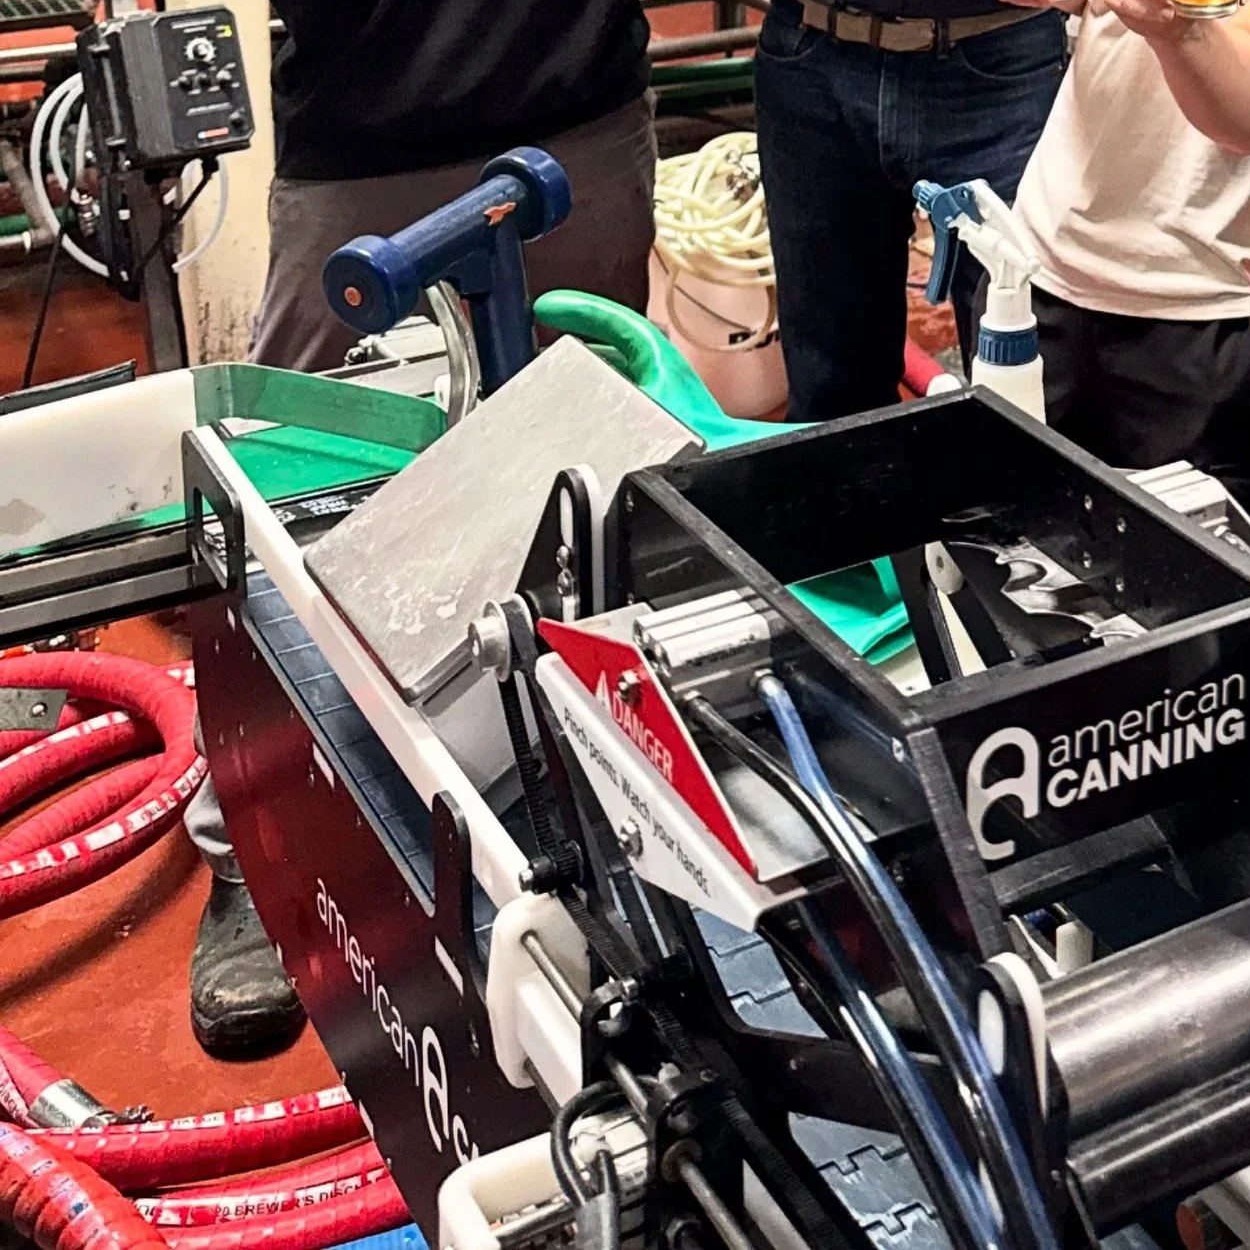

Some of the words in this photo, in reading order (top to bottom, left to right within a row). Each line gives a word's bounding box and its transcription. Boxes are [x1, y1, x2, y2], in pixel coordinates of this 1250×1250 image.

[612, 689, 674, 786] DANGER
[1045, 707, 1247, 809] CANNING
[1047, 672, 1246, 768] american
[564, 706, 589, 750] Pinch
[621, 773, 652, 826] Watch
[652, 815, 676, 853] your
[317, 877, 420, 1087] american
[234, 1194, 315, 1217] BREWER'S
